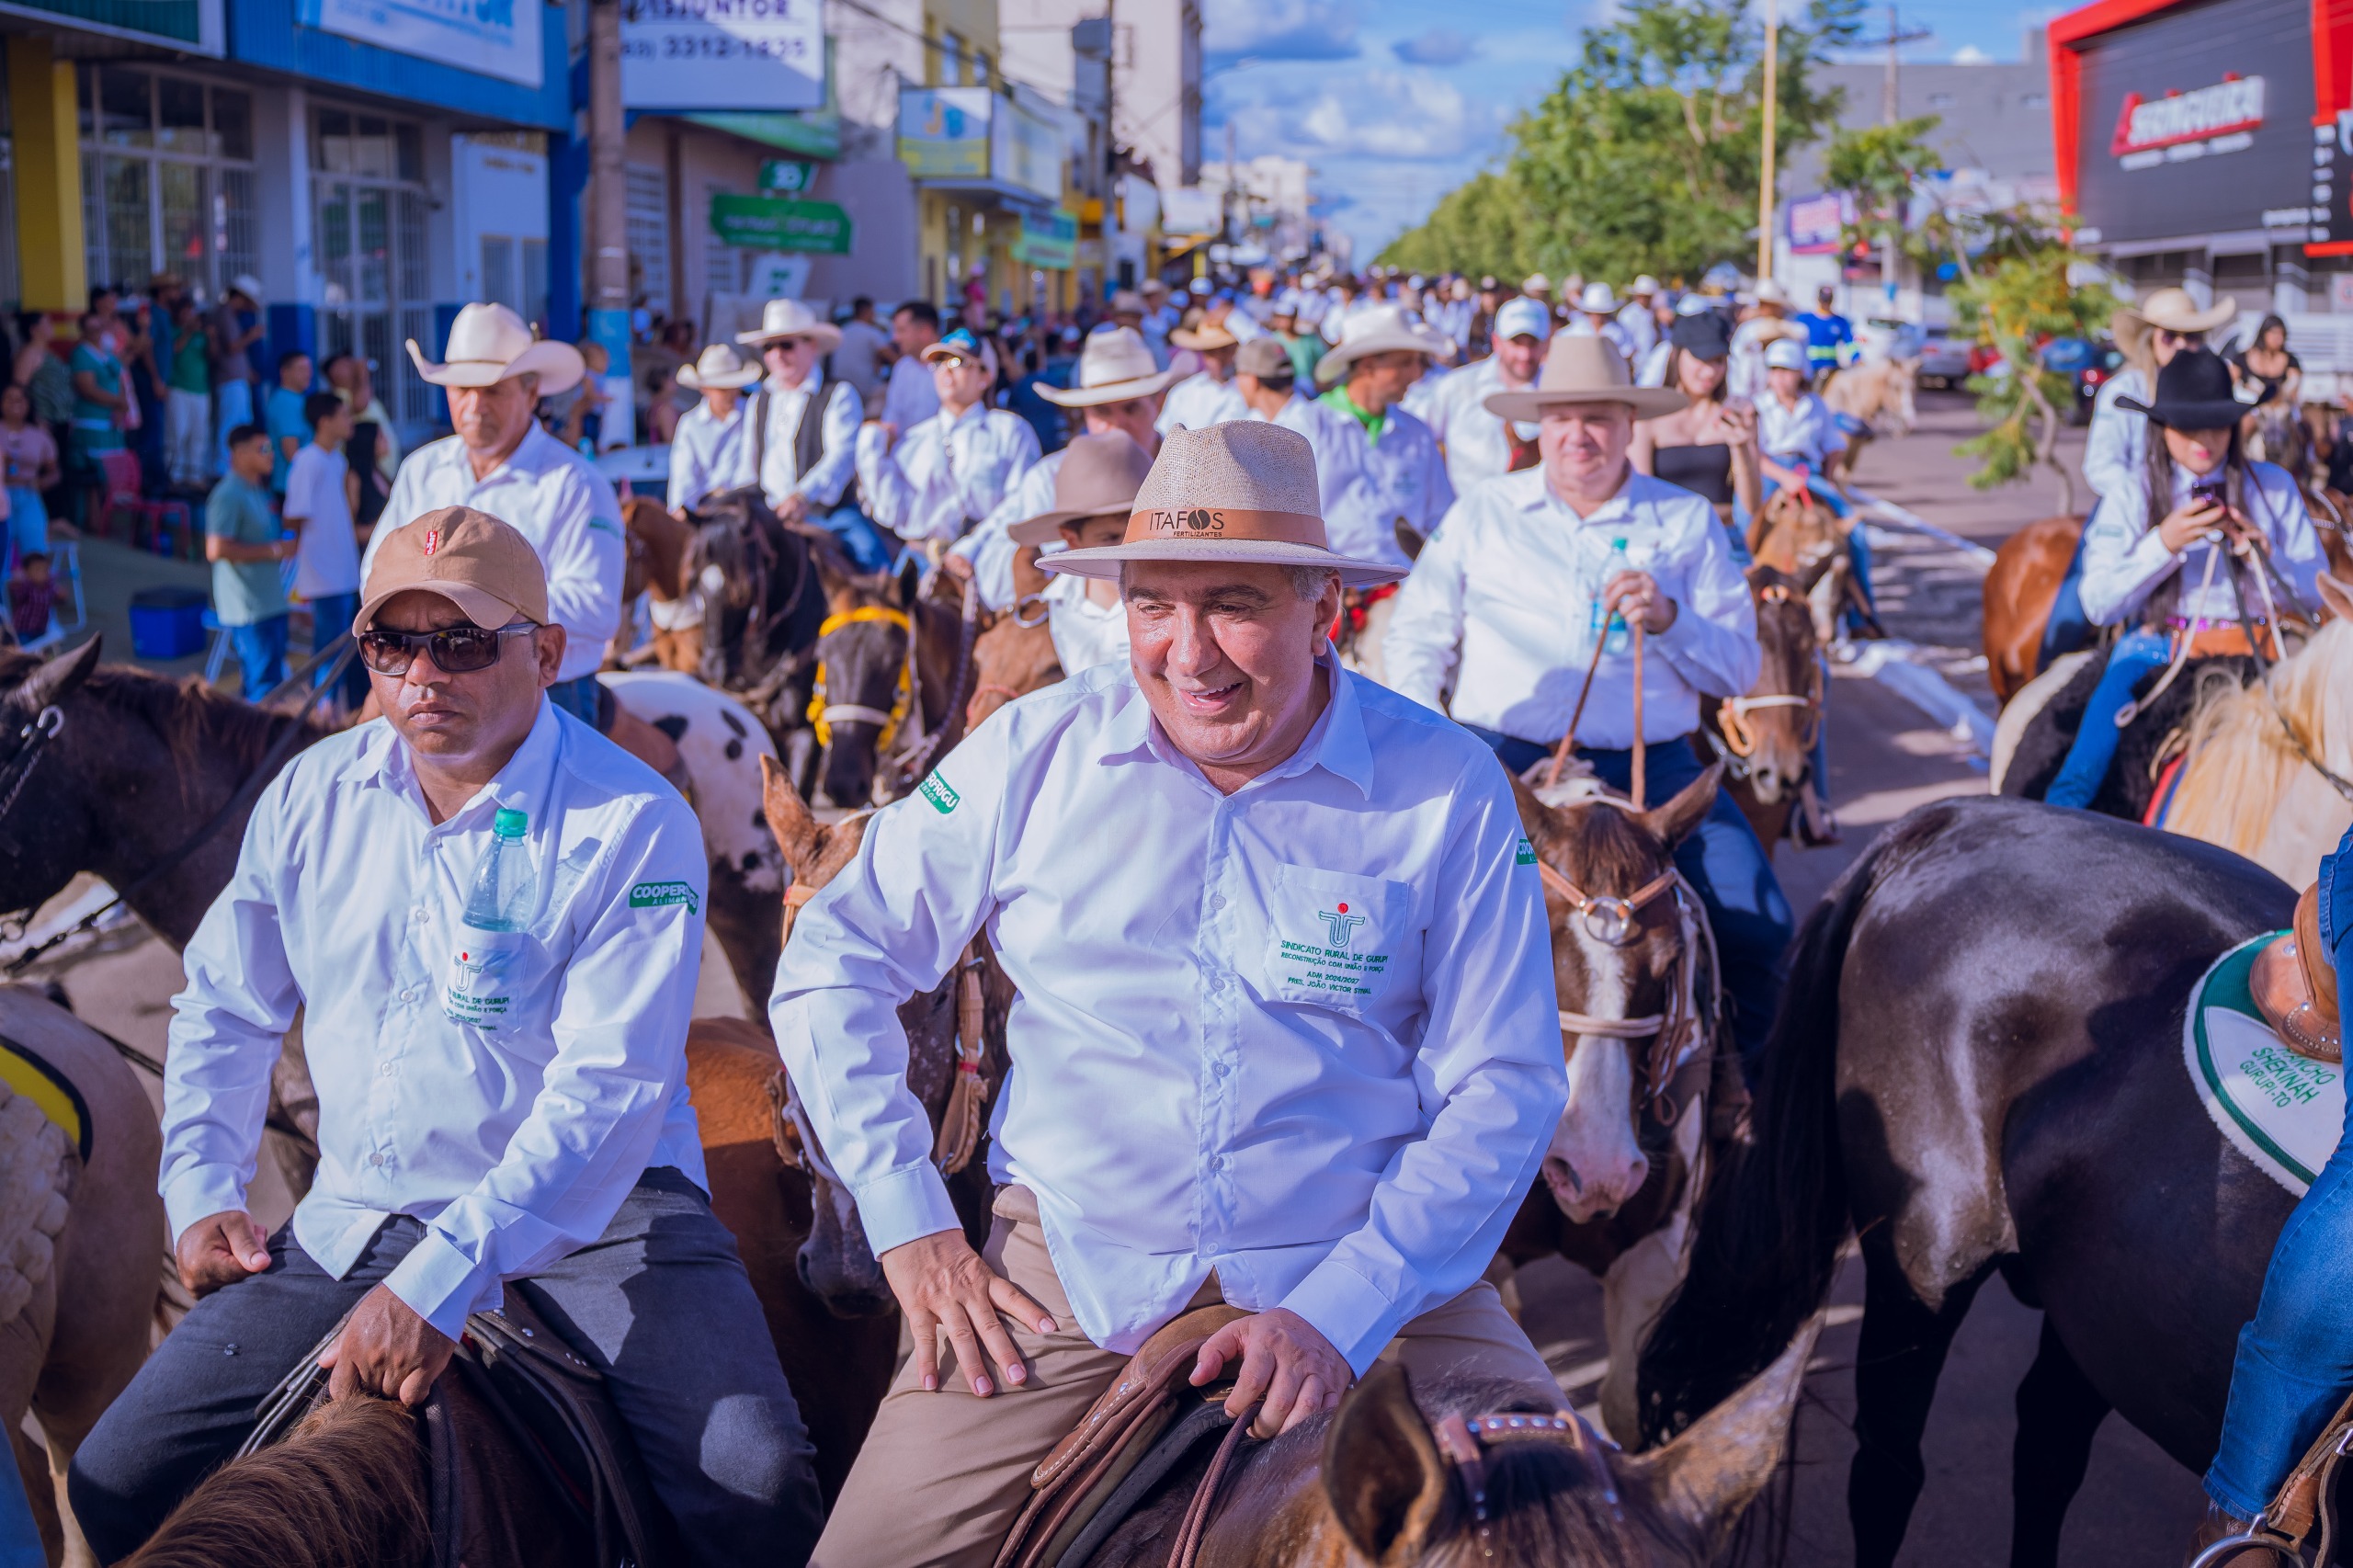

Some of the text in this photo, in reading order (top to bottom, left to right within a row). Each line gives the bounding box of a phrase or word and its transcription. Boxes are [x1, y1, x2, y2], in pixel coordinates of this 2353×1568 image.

[652, 895, 688, 905] ALIMEN
[1281, 939, 1389, 963] SINDICATO RURAL DE GURUPI
[1281, 952, 1326, 966] RECONSTRUÇÃO
[1328, 960, 1343, 969] COM
[1345, 962, 1362, 971] UNIÃO
[1369, 966, 1384, 974] FORÇA
[1287, 977, 1305, 985] PRES.
[1307, 980, 1326, 989] JOÃO
[1329, 983, 1352, 994] VICTOR
[1306, 971, 1359, 984] ADM 2024/2027
[484, 996, 509, 1006] GURUPI
[2239, 1061, 2291, 1108] GURUPI-TO
[2251, 1047, 2321, 1105] SHEKINAH
